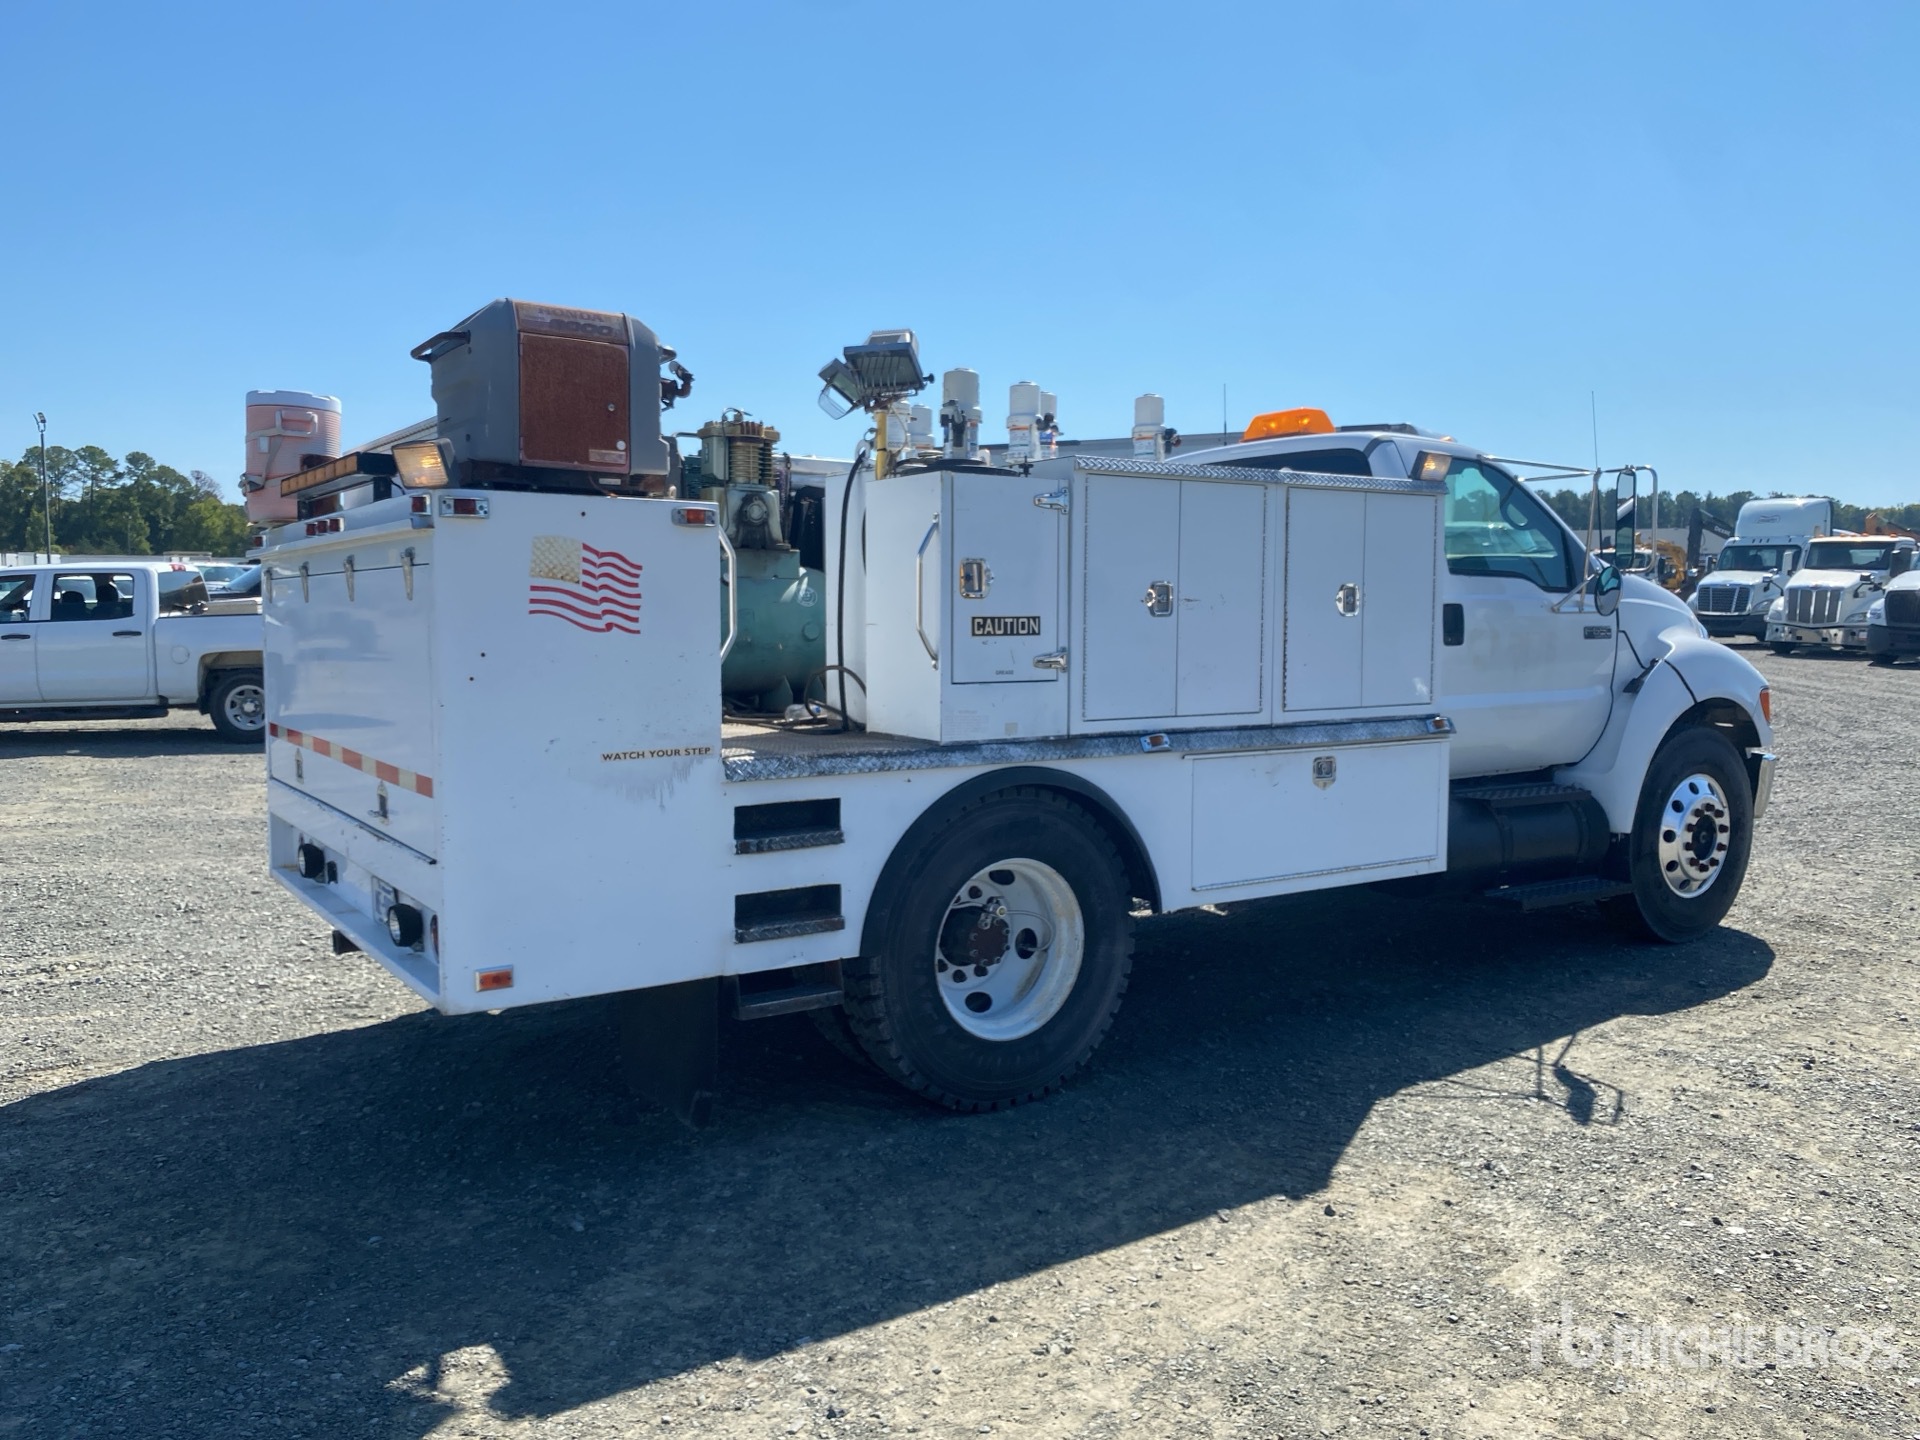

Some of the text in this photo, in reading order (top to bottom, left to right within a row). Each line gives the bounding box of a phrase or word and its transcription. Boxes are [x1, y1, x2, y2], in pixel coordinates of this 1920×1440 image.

[974, 618, 1039, 635] CAUTION
[602, 747, 711, 761] WATCH YOUR STEP
